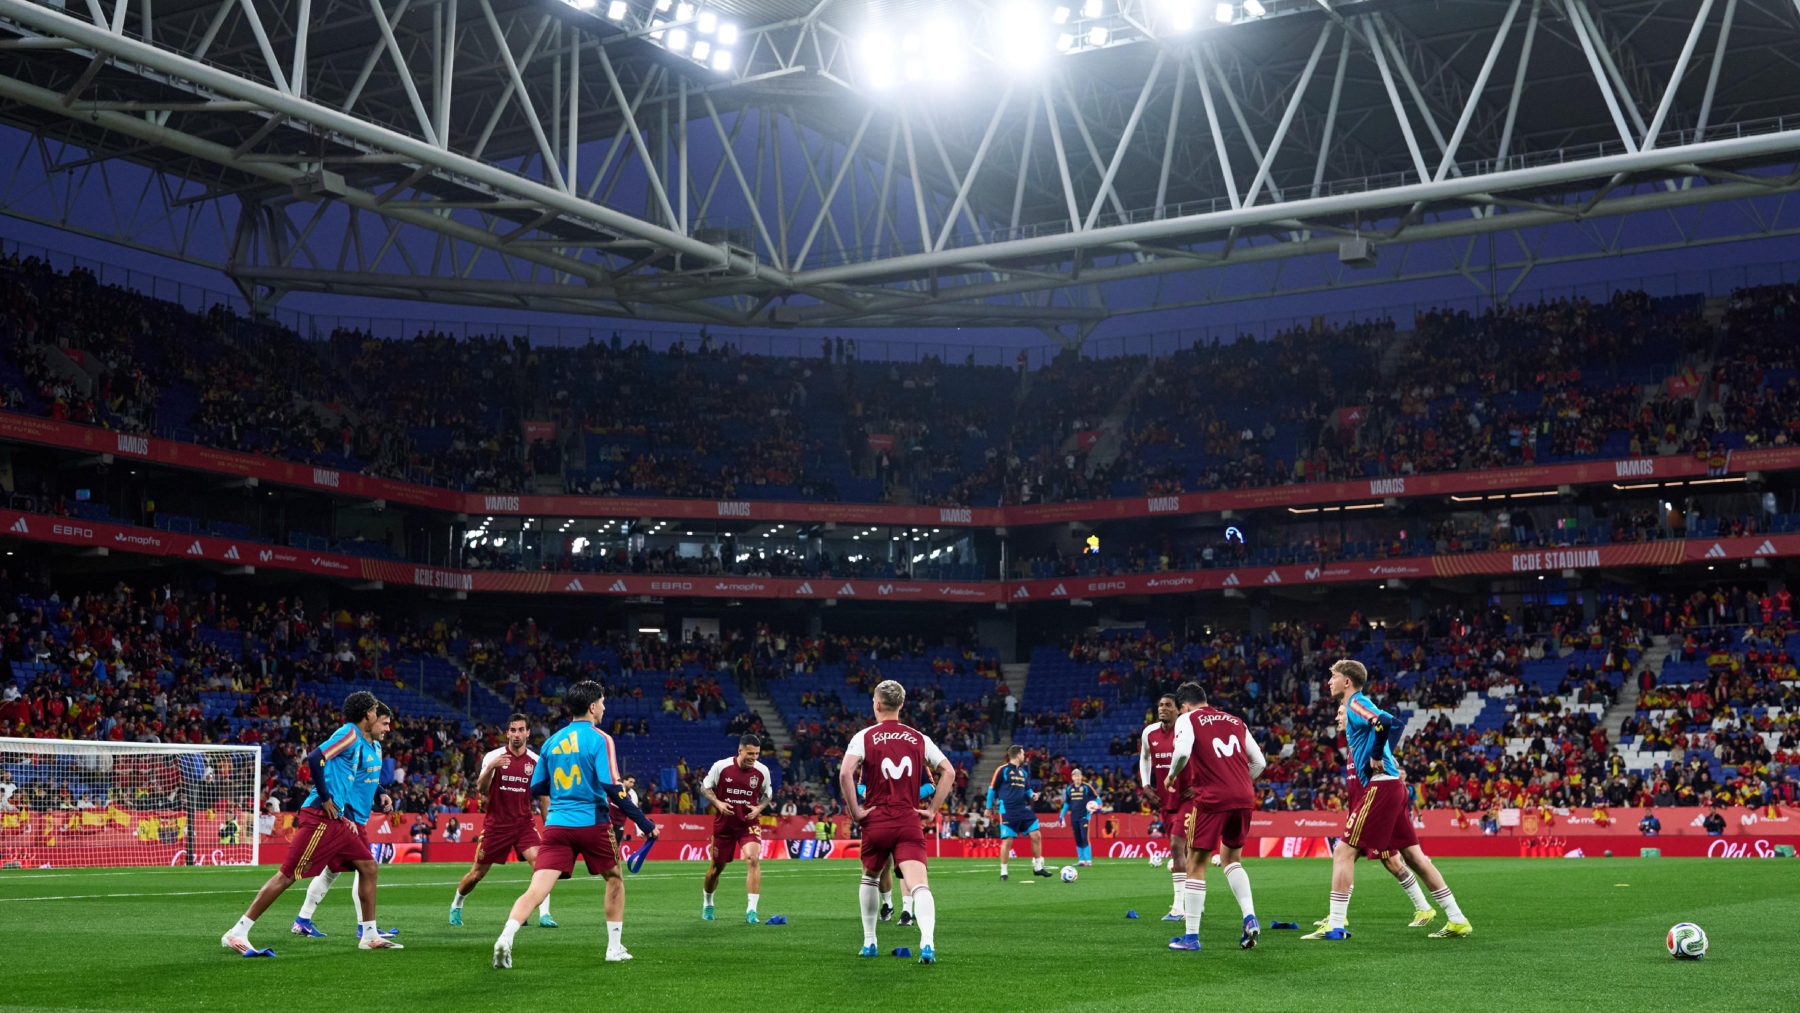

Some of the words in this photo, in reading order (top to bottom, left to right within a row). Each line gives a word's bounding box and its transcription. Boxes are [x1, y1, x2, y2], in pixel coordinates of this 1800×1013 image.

[118, 434, 148, 455] VAMOS
[1615, 460, 1653, 477] VAMOS
[314, 467, 339, 487] VAMOS
[1370, 478, 1404, 495] VAMOS
[485, 496, 519, 511] VAMOS
[717, 501, 750, 516] VAMOS
[1148, 497, 1179, 512] VAMOS
[940, 509, 972, 523] VAMOS
[53, 524, 93, 538] EBRO
[127, 534, 161, 547] mapfre
[1512, 553, 1542, 572] RCDE
[1544, 549, 1600, 570] STADIUM
[414, 568, 434, 587] RCDE
[435, 571, 473, 590] STADIUM
[651, 582, 692, 590] EBRO
[1088, 581, 1125, 591] EBRO
[1160, 577, 1194, 589] mapfre
[729, 583, 766, 592] mapfre
[1198, 713, 1239, 728] España
[872, 731, 918, 746] España
[502, 775, 529, 784] EBRO
